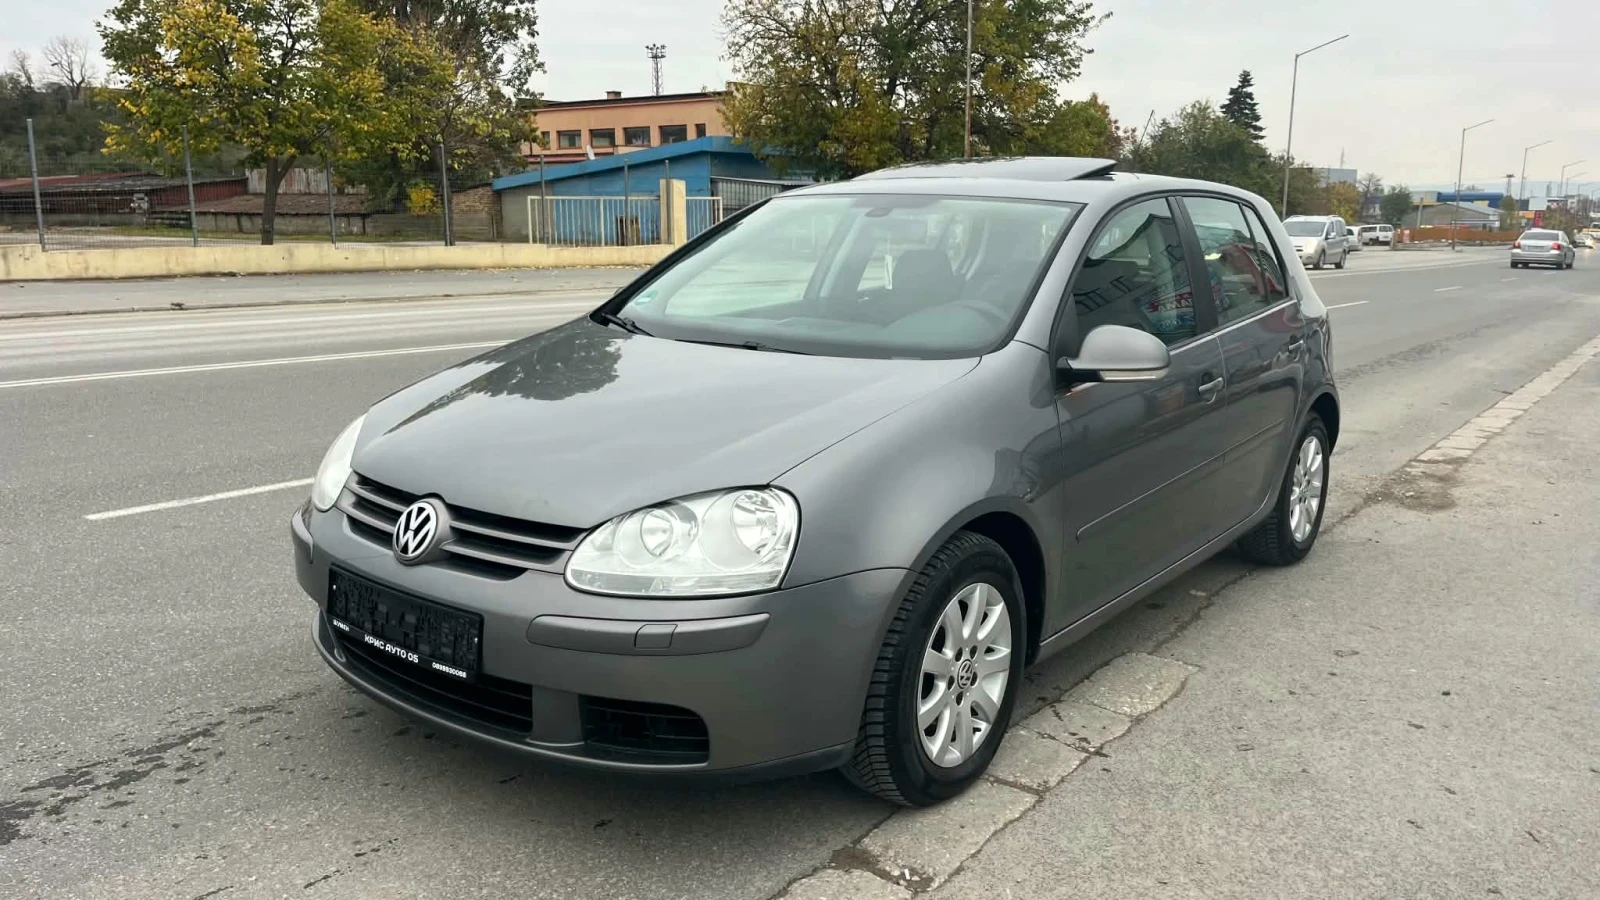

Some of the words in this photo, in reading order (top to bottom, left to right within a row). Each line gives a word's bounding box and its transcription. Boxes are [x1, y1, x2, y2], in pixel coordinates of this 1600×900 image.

[395, 503, 437, 556] VW
[364, 634, 384, 650] КРИС
[385, 643, 407, 659] АУТО
[407, 652, 419, 663] 05
